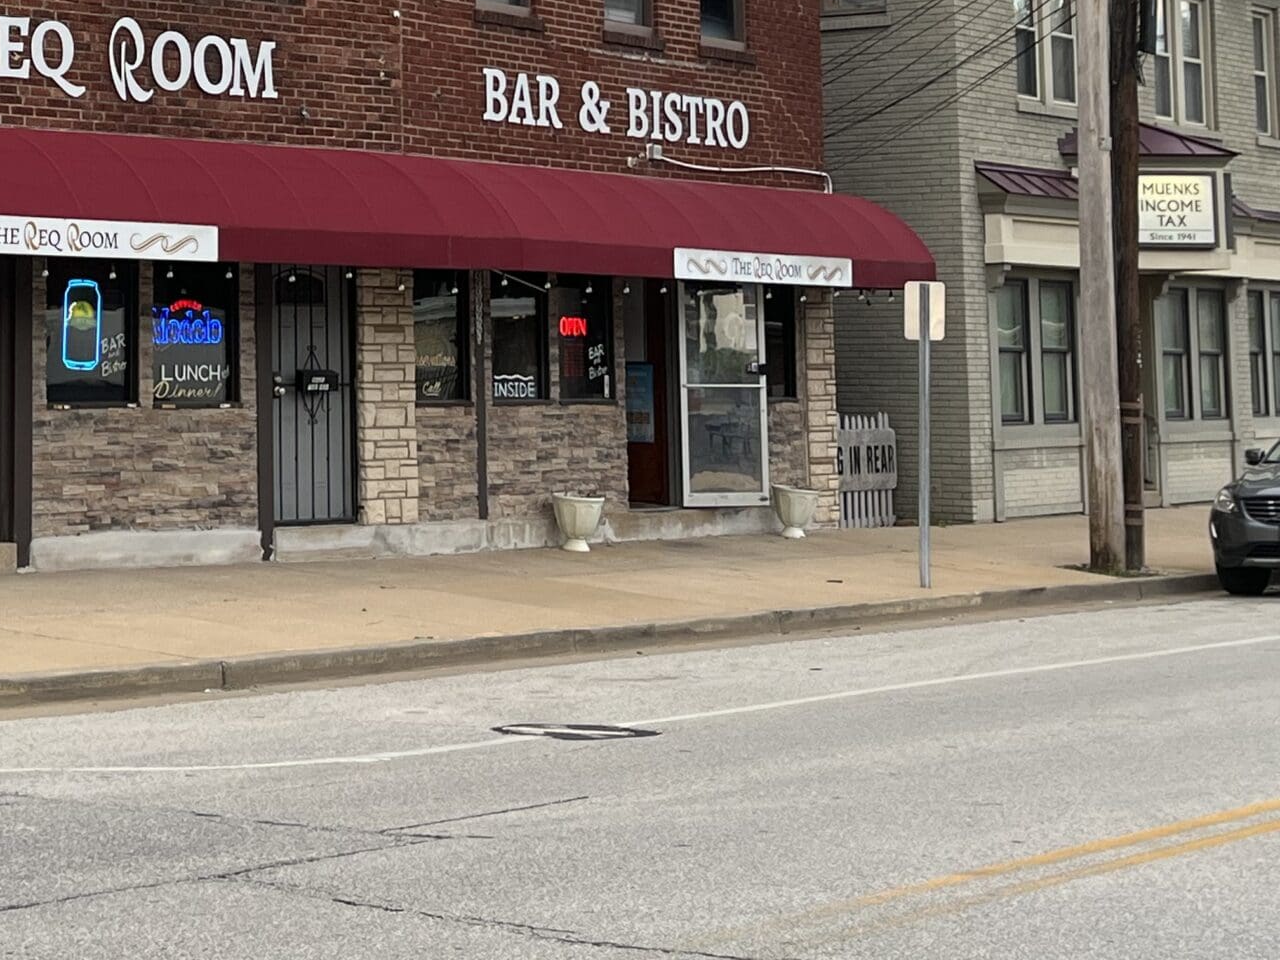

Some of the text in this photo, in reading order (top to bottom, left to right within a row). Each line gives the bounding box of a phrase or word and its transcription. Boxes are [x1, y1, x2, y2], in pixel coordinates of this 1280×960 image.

[108, 16, 278, 103] ROOM
[482, 67, 749, 150] BAR & BISTRO
[1142, 183, 1200, 195] MUENKS
[1140, 199, 1202, 212] INCOME
[1157, 214, 1187, 227] TAX
[23, 221, 63, 252] REQ
[66, 223, 119, 252] ROOM
[1149, 233, 1196, 241] Since 1941
[732, 256, 802, 281] THE REQ ROOM
[559, 316, 587, 336] OPEN
[101, 333, 126, 354] BAR
[161, 364, 221, 382] LUNCH
[494, 382, 535, 397] INSIDE
[849, 446, 861, 476] IN
[866, 444, 895, 474] REAR
